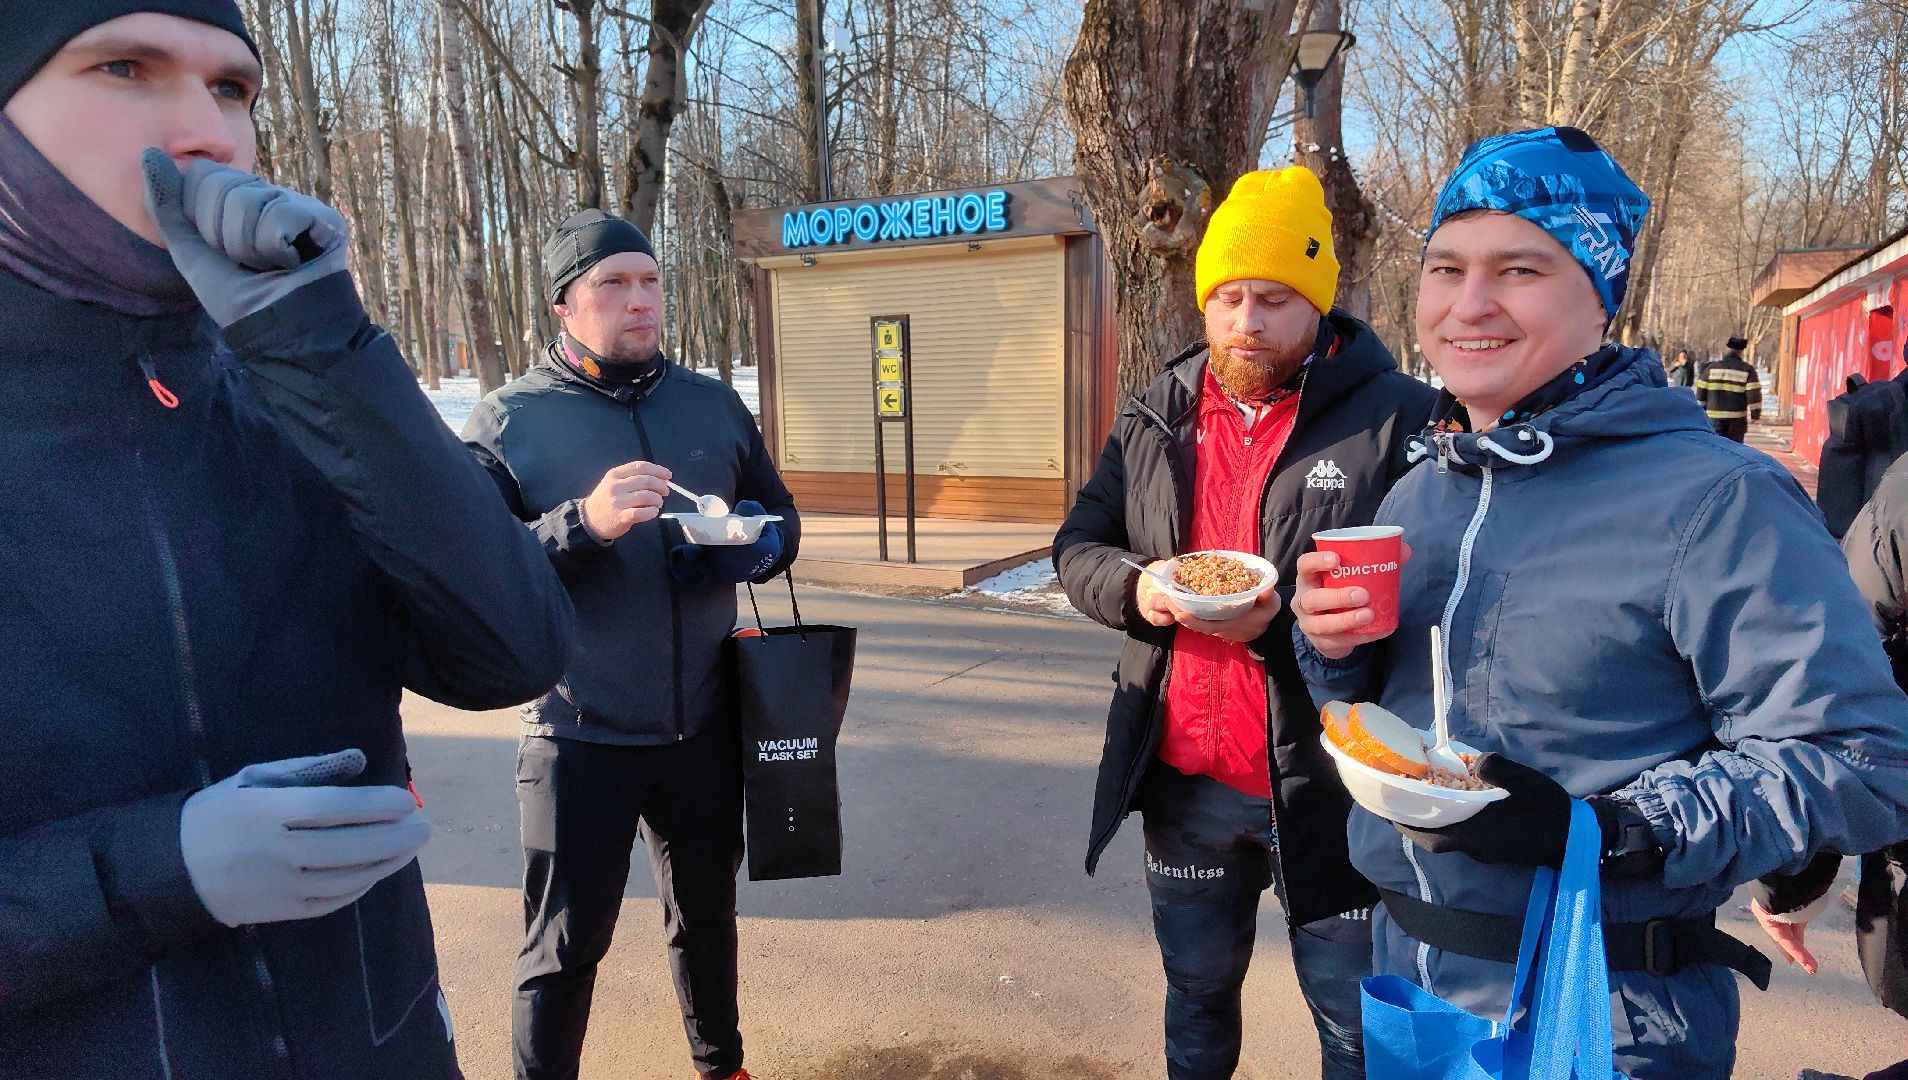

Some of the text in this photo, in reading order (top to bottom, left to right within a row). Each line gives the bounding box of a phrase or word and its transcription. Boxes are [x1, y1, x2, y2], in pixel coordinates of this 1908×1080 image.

[783, 189, 1007, 248] МОРОЖЕНОЕ
[881, 364, 897, 374] WC
[1306, 477, 1346, 490] Kappa
[758, 737, 818, 752] VACUUM
[758, 749, 819, 762] FLASK SET
[1146, 850, 1225, 880] Relentless
